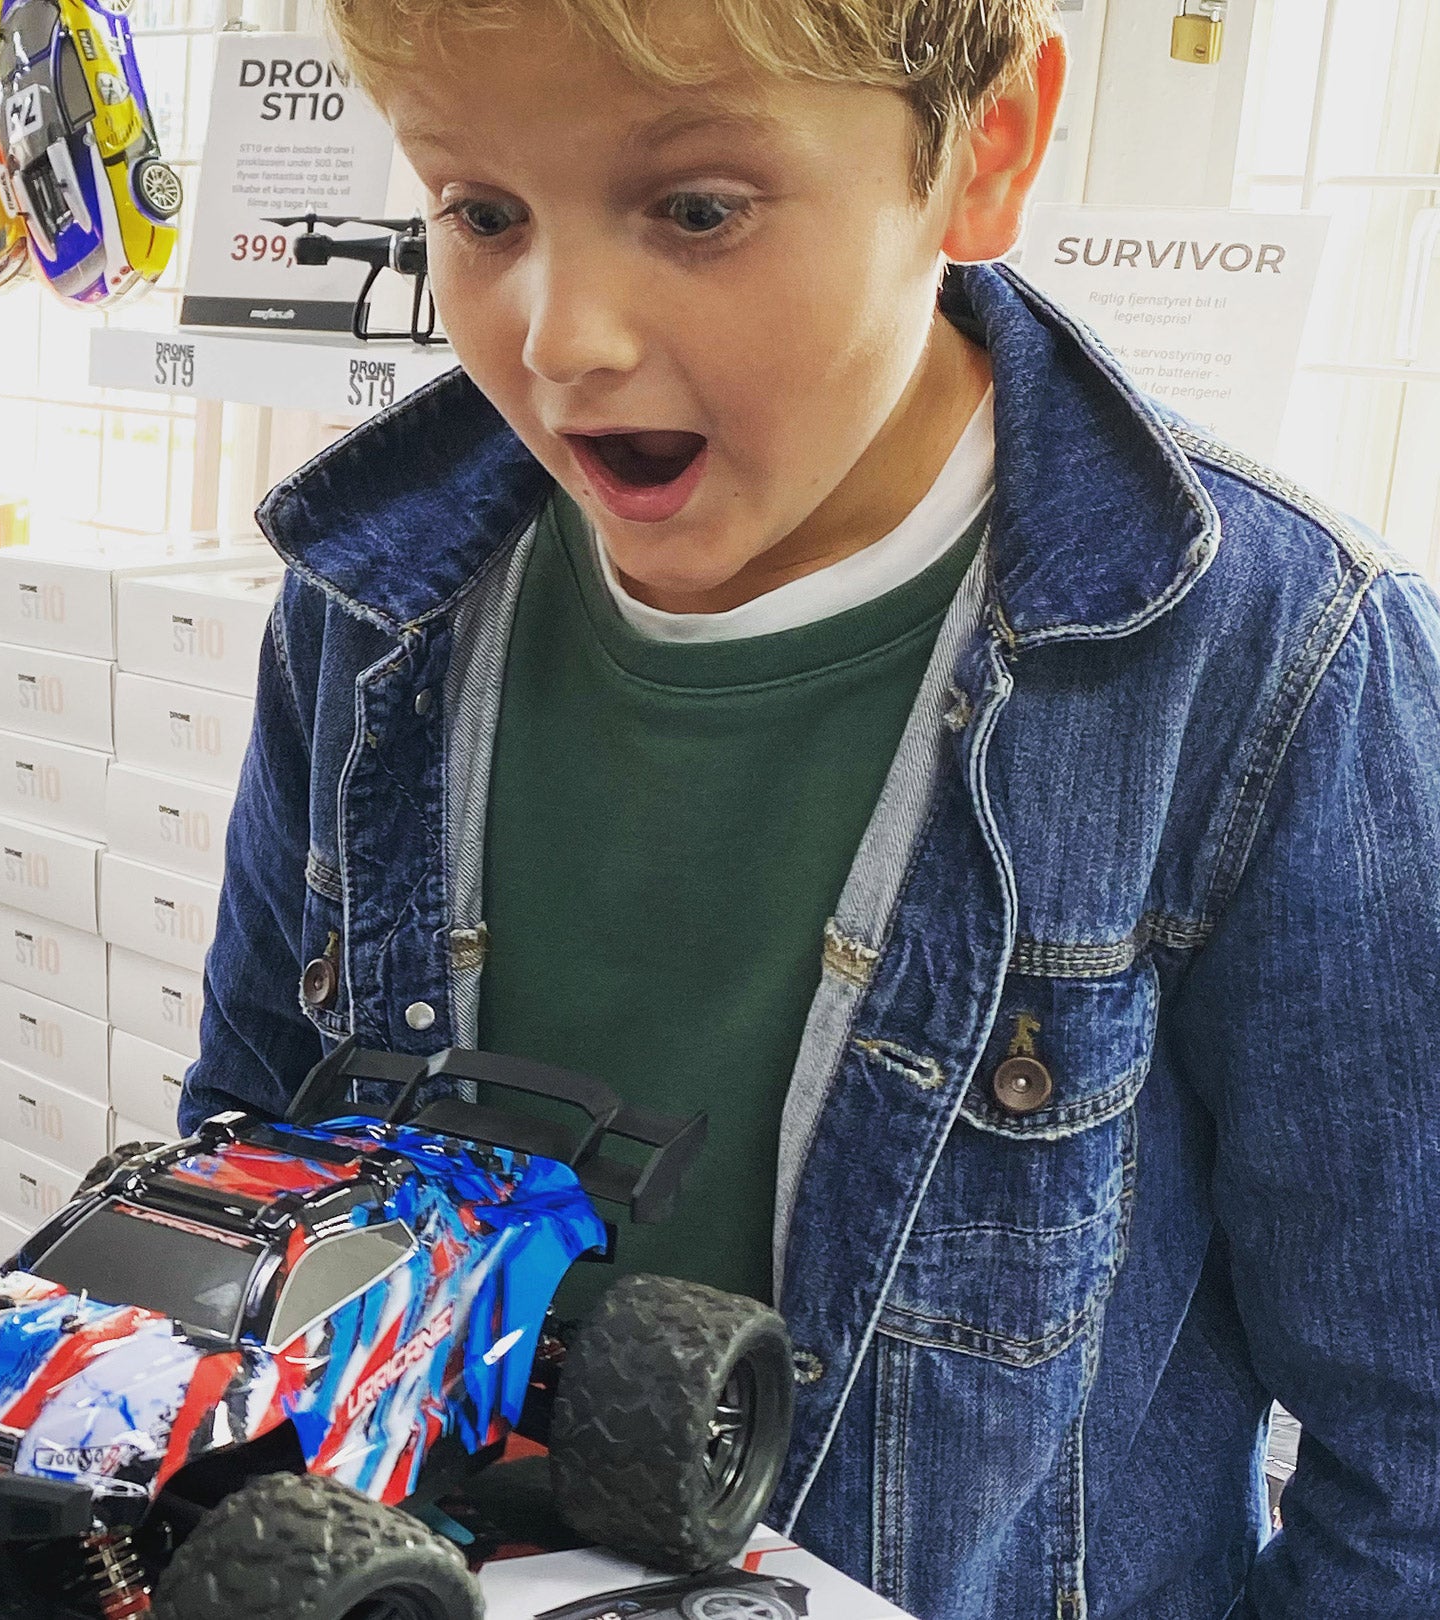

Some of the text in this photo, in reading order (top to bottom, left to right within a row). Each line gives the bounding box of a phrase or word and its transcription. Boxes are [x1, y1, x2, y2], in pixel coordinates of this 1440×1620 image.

[239, 59, 357, 88] DRON
[260, 92, 344, 121] ST10
[230, 234, 296, 267] 399,
[1054, 236, 1287, 275] SURVIVOR
[1089, 291, 1124, 306] Rigtig
[1195, 296, 1211, 308] bil
[1214, 297, 1227, 308] til
[156, 343, 195, 358] DRONE
[1215, 353, 1232, 364] og
[155, 356, 195, 387] ST9
[349, 359, 396, 377] DRONE
[347, 373, 396, 407] ST9
